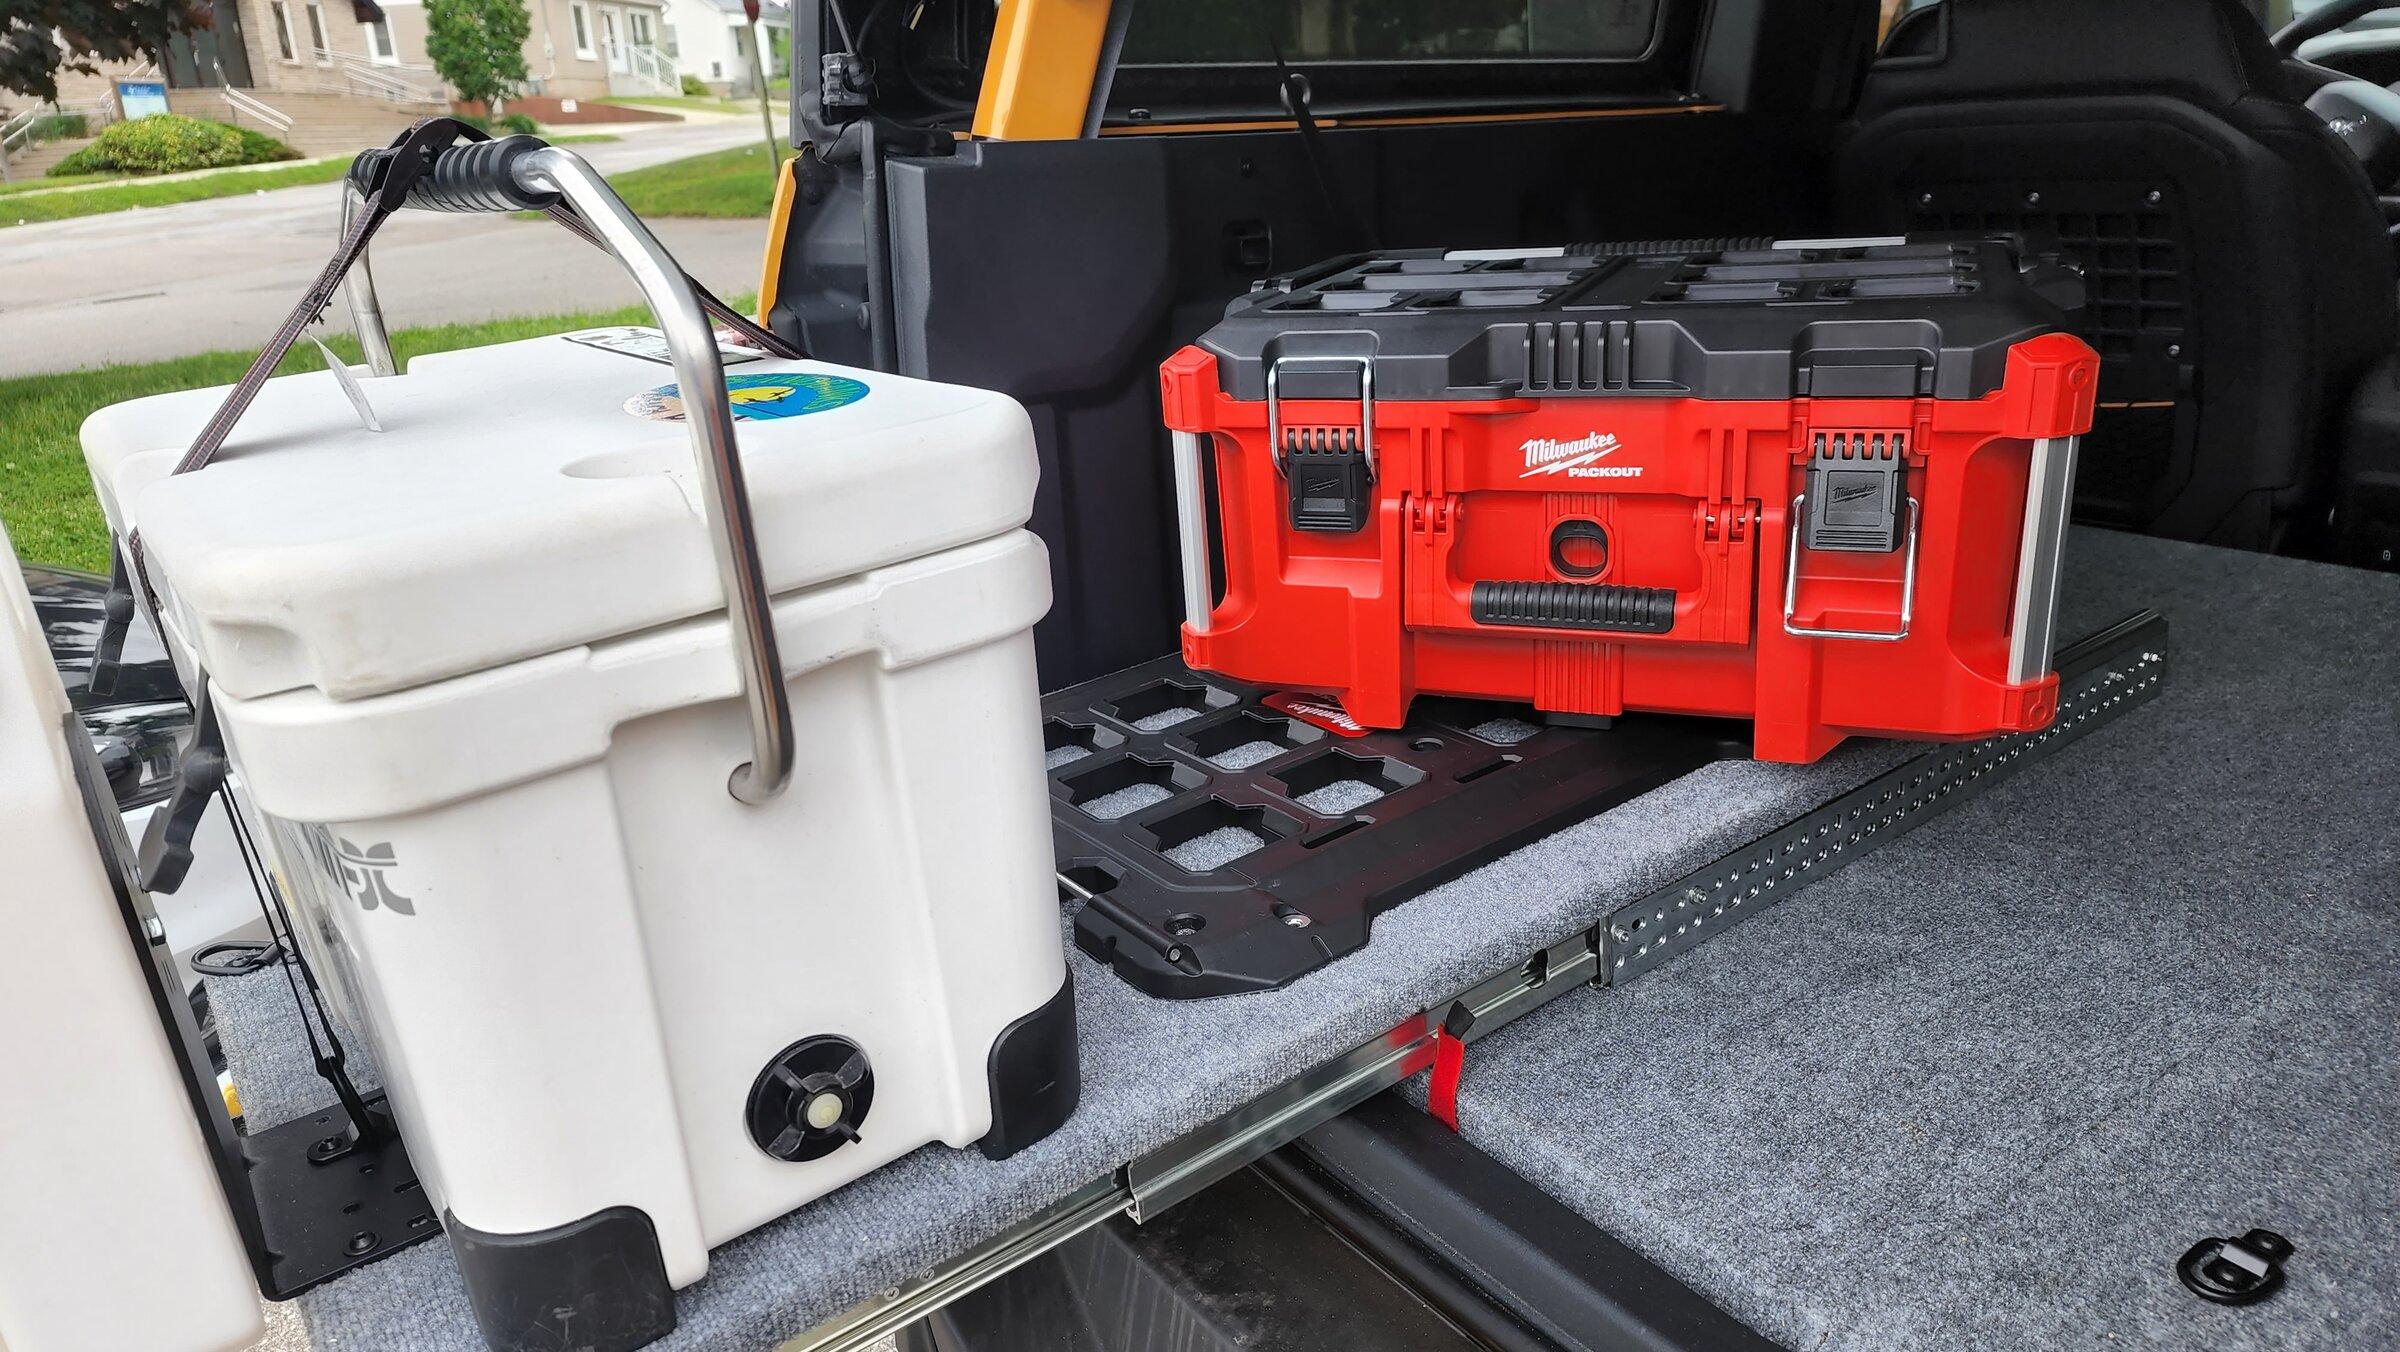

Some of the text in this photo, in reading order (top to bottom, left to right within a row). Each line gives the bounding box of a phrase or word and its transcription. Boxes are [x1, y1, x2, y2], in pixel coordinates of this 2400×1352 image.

[1519, 431, 1616, 467] Milwaukee
[1568, 467, 1643, 478] PACKOUT
[1286, 702, 1365, 731] Milwaukee
